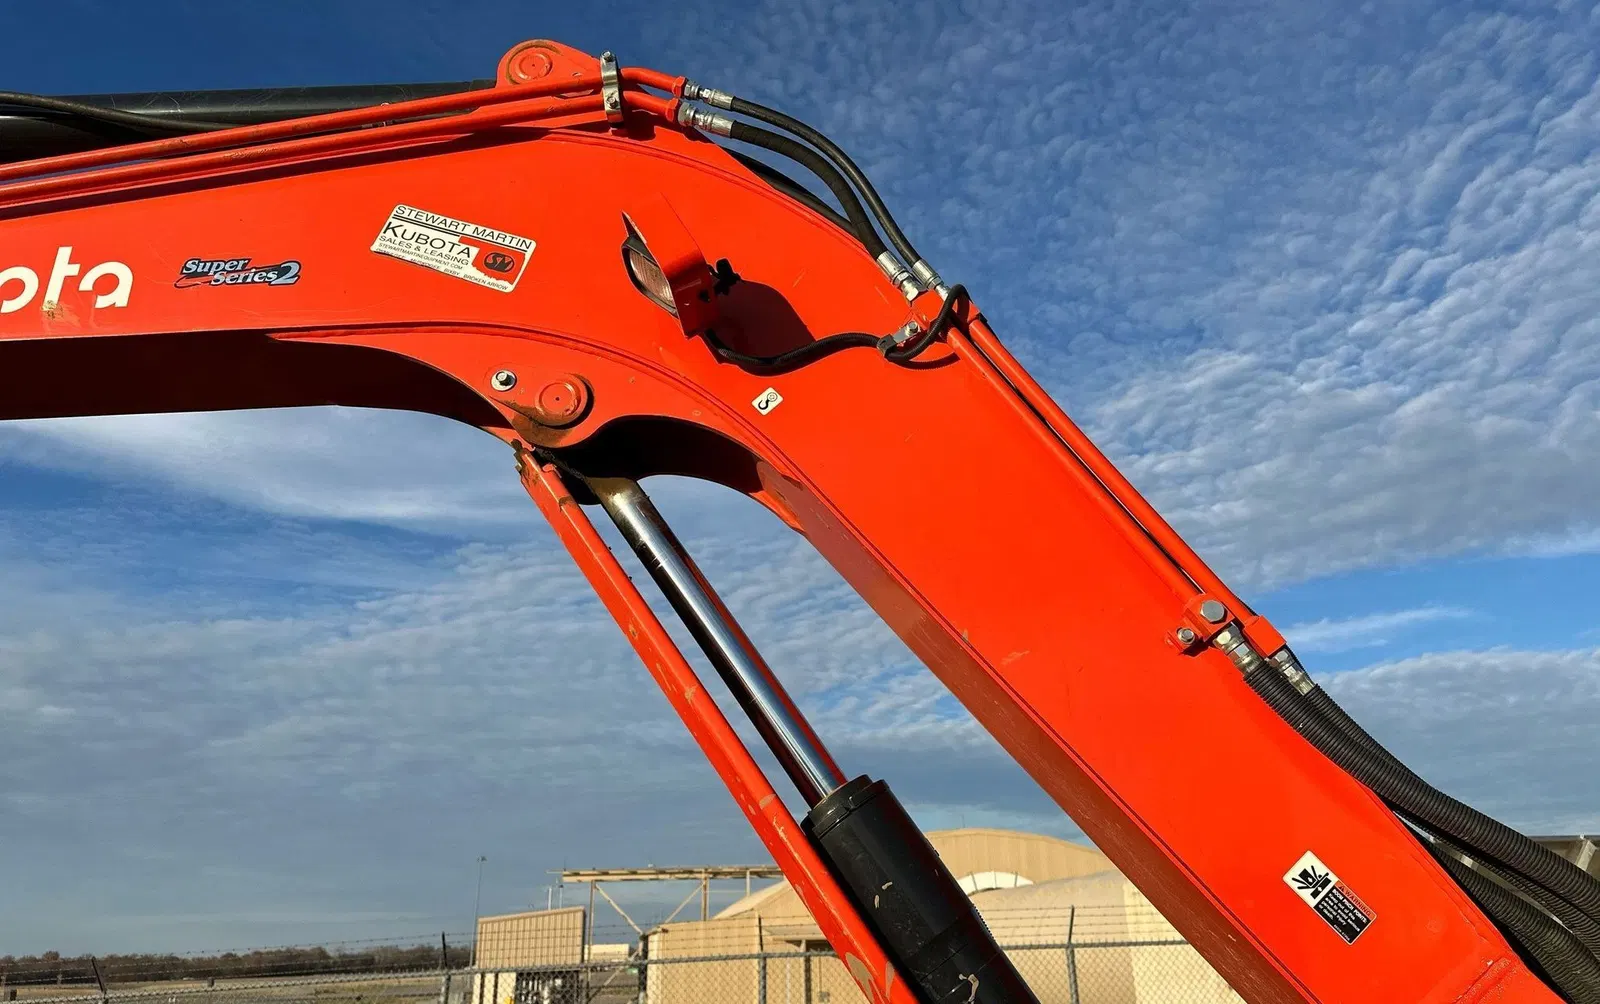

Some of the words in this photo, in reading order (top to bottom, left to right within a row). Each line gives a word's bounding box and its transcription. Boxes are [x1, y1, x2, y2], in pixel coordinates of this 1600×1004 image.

[395, 205, 470, 232] STEWART
[472, 226, 533, 250] MARTIN
[382, 221, 471, 258] KUBOTA
[379, 235, 413, 249] SALES
[424, 248, 469, 266] LEASING
[182, 259, 249, 277] Super
[211, 269, 278, 285] Series
[463, 273, 487, 284] BROKEN
[487, 281, 509, 290] ARROW
[1332, 889, 1344, 900] BOOM
[1345, 891, 1372, 916] WARNING
[1337, 909, 1348, 920] avoid
[1347, 919, 1361, 932] serious
[1348, 912, 1356, 920] this
